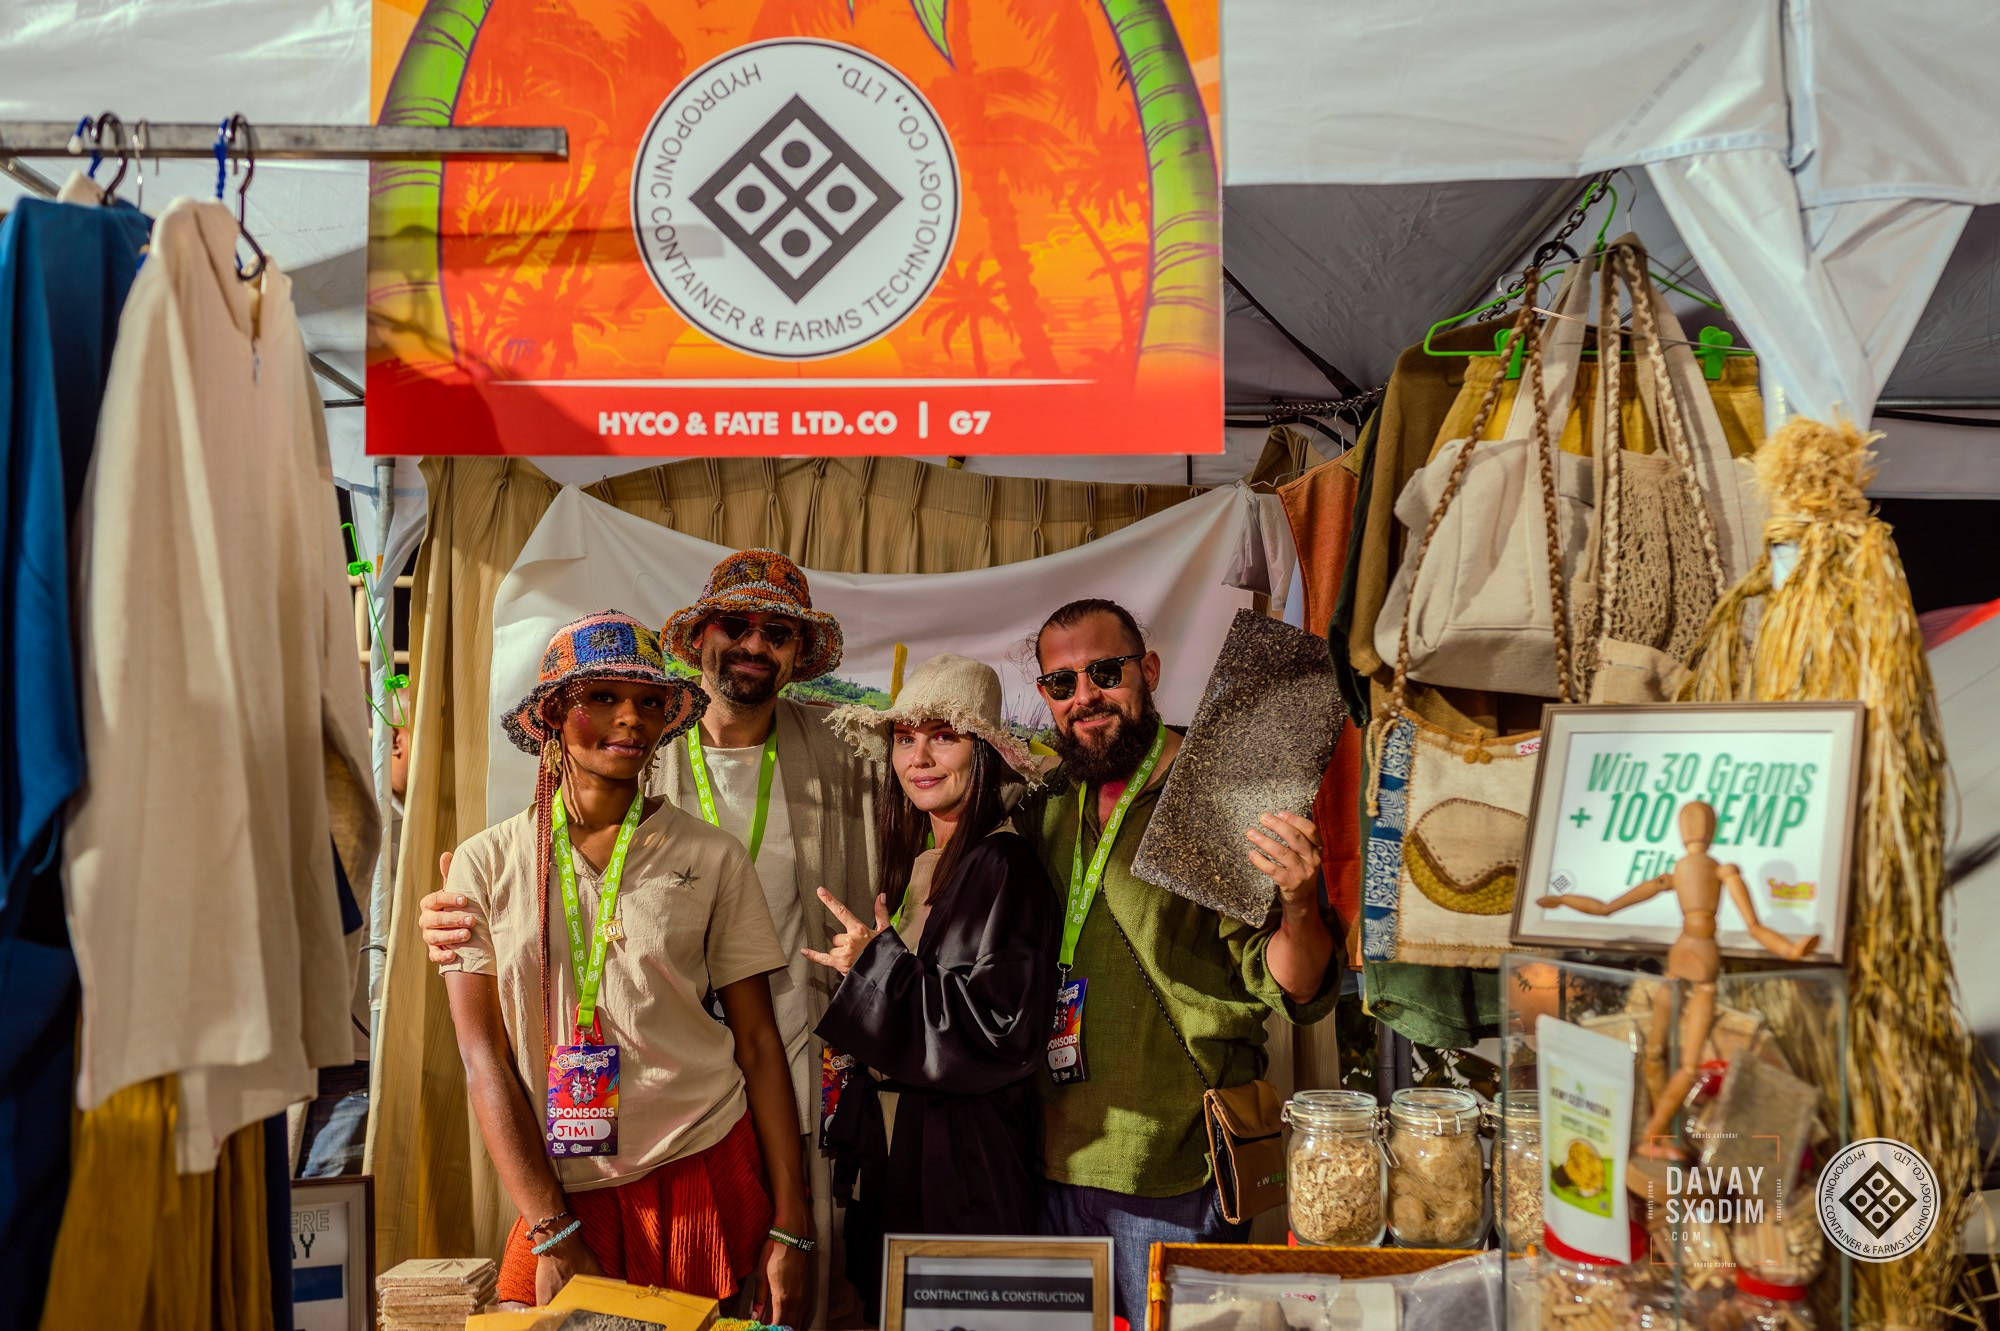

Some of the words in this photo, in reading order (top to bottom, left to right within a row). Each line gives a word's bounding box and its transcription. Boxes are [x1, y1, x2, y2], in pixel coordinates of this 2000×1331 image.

[836, 62, 888, 104] LTD.
[651, 62, 762, 200] HYDROPONIC
[862, 158, 942, 317] TECHNOLOGY
[651, 207, 746, 330] CONTAINER
[750, 317, 765, 338] &
[774, 307, 862, 342] FARMS
[598, 411, 680, 436] HYCO
[685, 411, 708, 436] &
[714, 411, 779, 436] FATE
[792, 411, 897, 436] LTD.CO
[948, 411, 991, 435] G7
[1586, 752, 1648, 792] Win
[1654, 752, 1702, 794] 30
[1706, 752, 1819, 796] Grams
[1569, 806, 1592, 829] +
[1602, 792, 1677, 843] 100
[1697, 793, 1809, 847] EMP
[549, 1107, 615, 1118] SPONSORS
[557, 1125, 595, 1137] JIMI
[291, 1209, 330, 1233] ERE
[914, 1289, 989, 1302] CONTRACTING
[990, 1291, 1000, 1302] &
[1002, 1290, 1085, 1304] CONSTRUCTION
